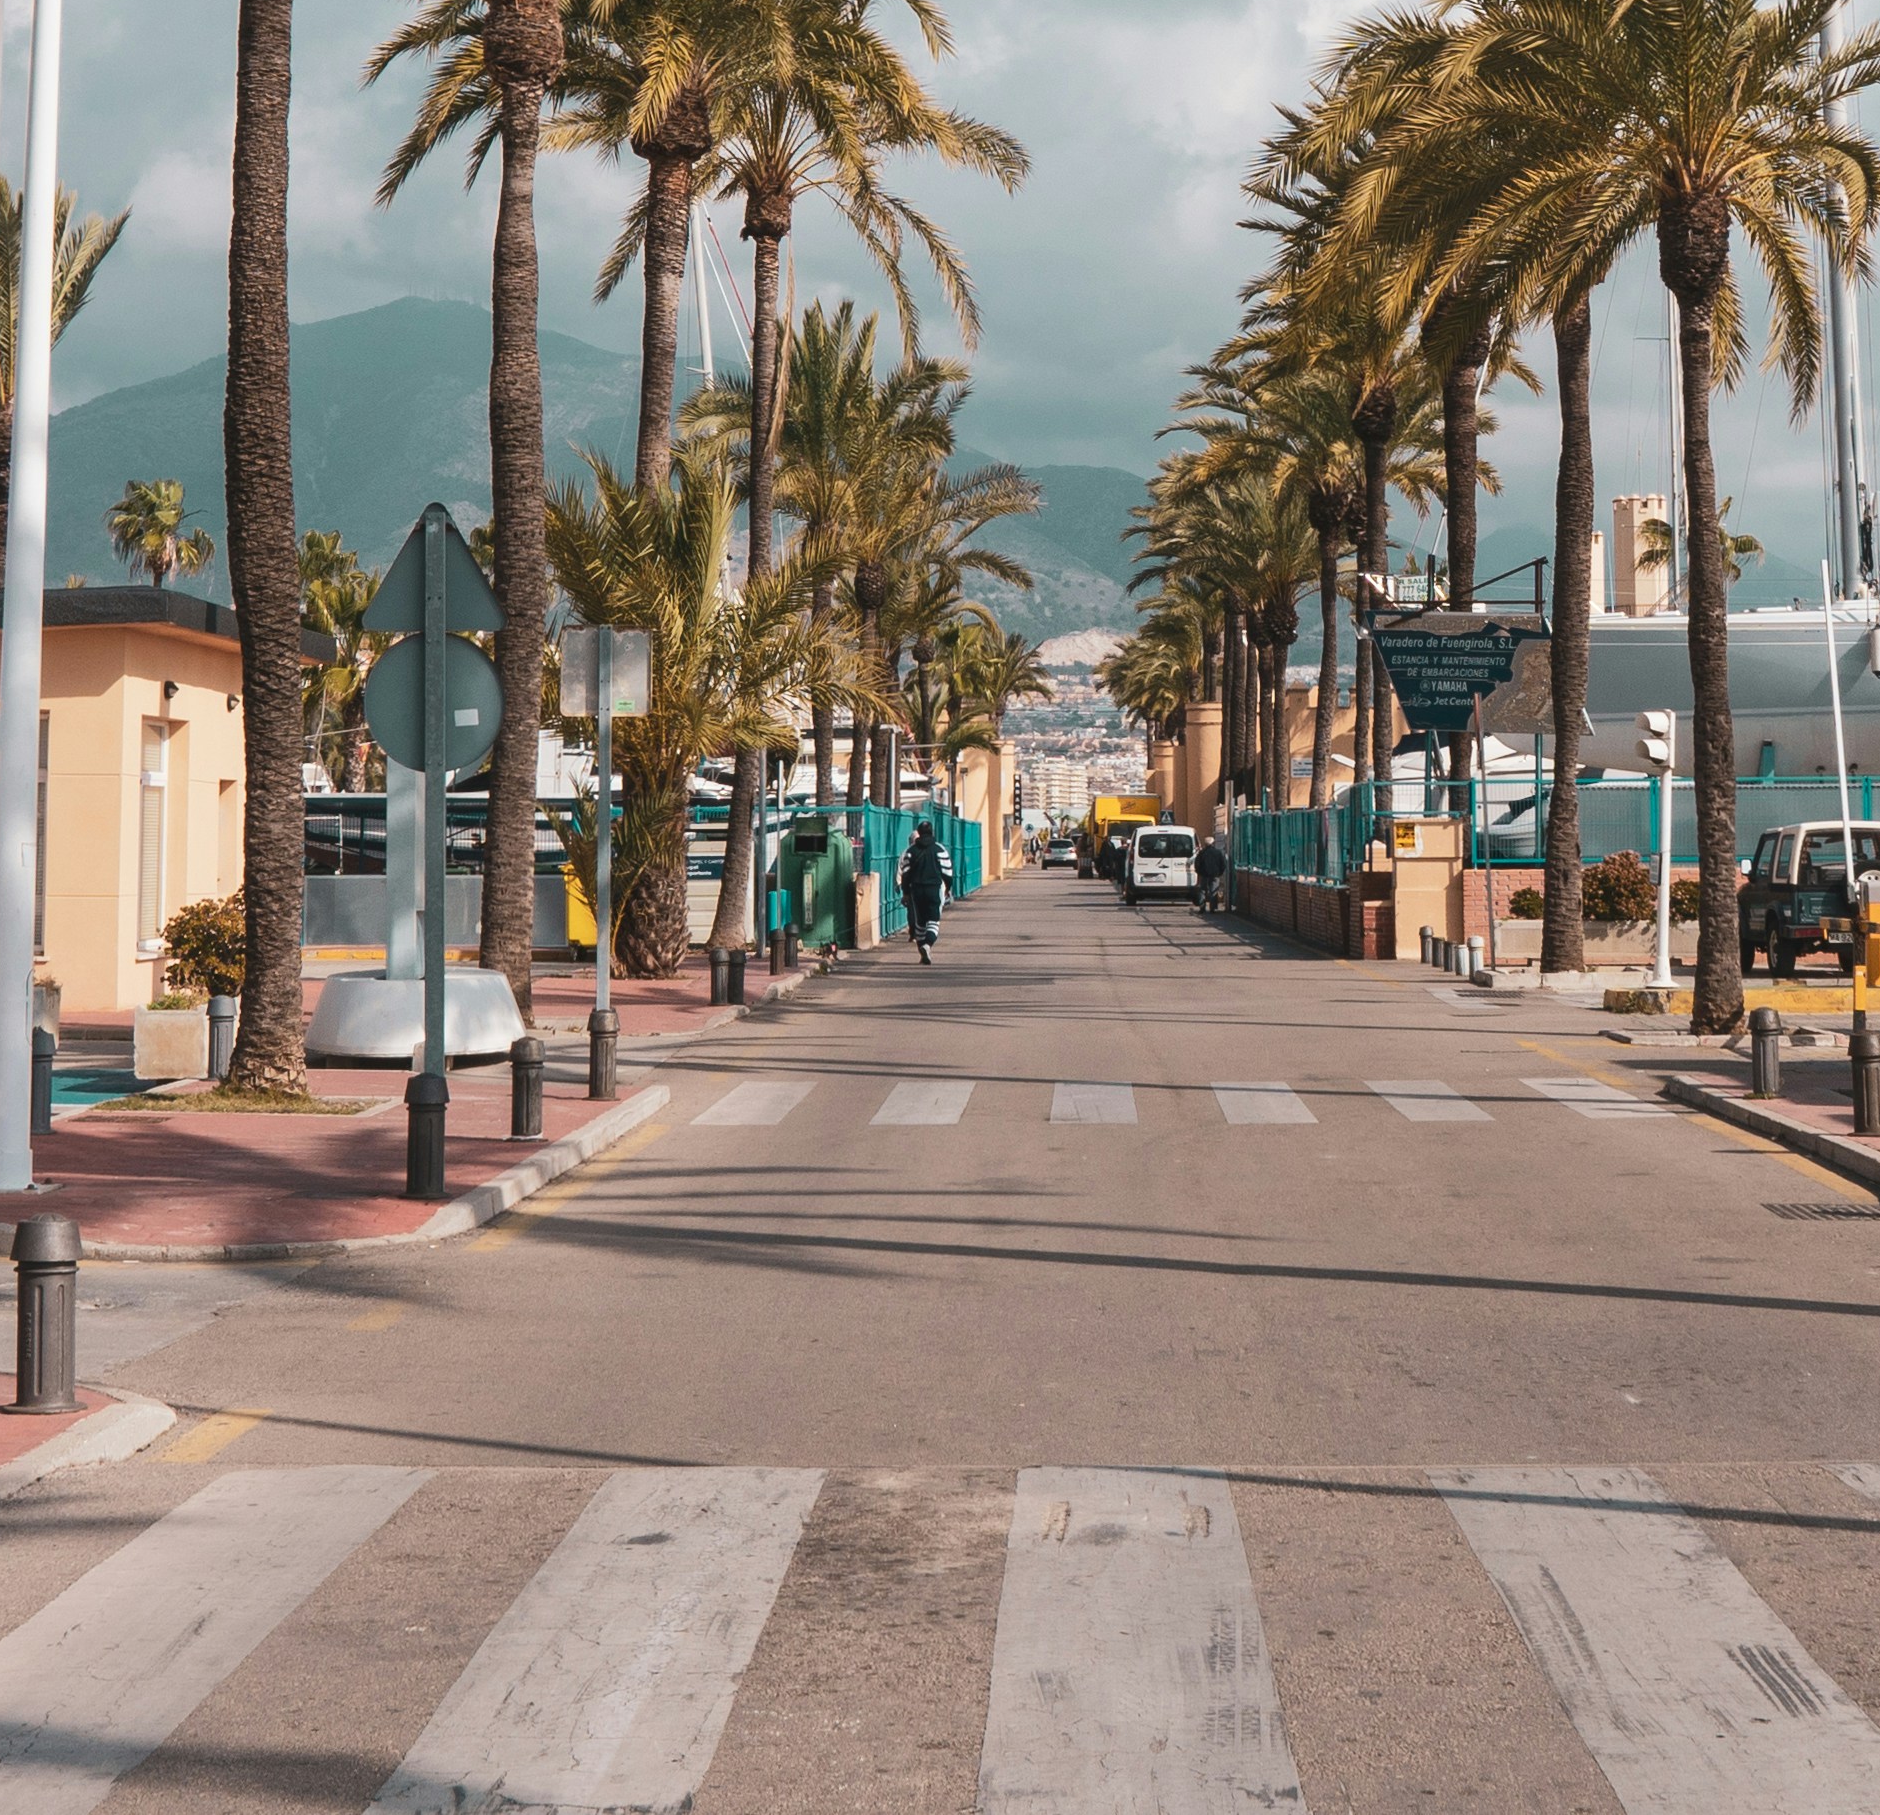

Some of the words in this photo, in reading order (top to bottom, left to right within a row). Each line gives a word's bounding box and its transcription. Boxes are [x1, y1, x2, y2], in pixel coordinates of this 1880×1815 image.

[1381, 636, 1423, 647] Varadero
[1426, 637, 1438, 647] de
[1440, 636, 1495, 650] Fuengirola,
[1391, 655, 1429, 664] ESTANCIA
[1433, 656, 1438, 664] Y
[1442, 656, 1506, 666] MANTENIMIENTO
[1407, 667, 1418, 676] DE
[1421, 668, 1489, 678] EMBARCACIONES
[1431, 681, 1468, 692] YAMAHA
[1434, 696, 1448, 705] Jet
[1450, 696, 1474, 706] Cente
